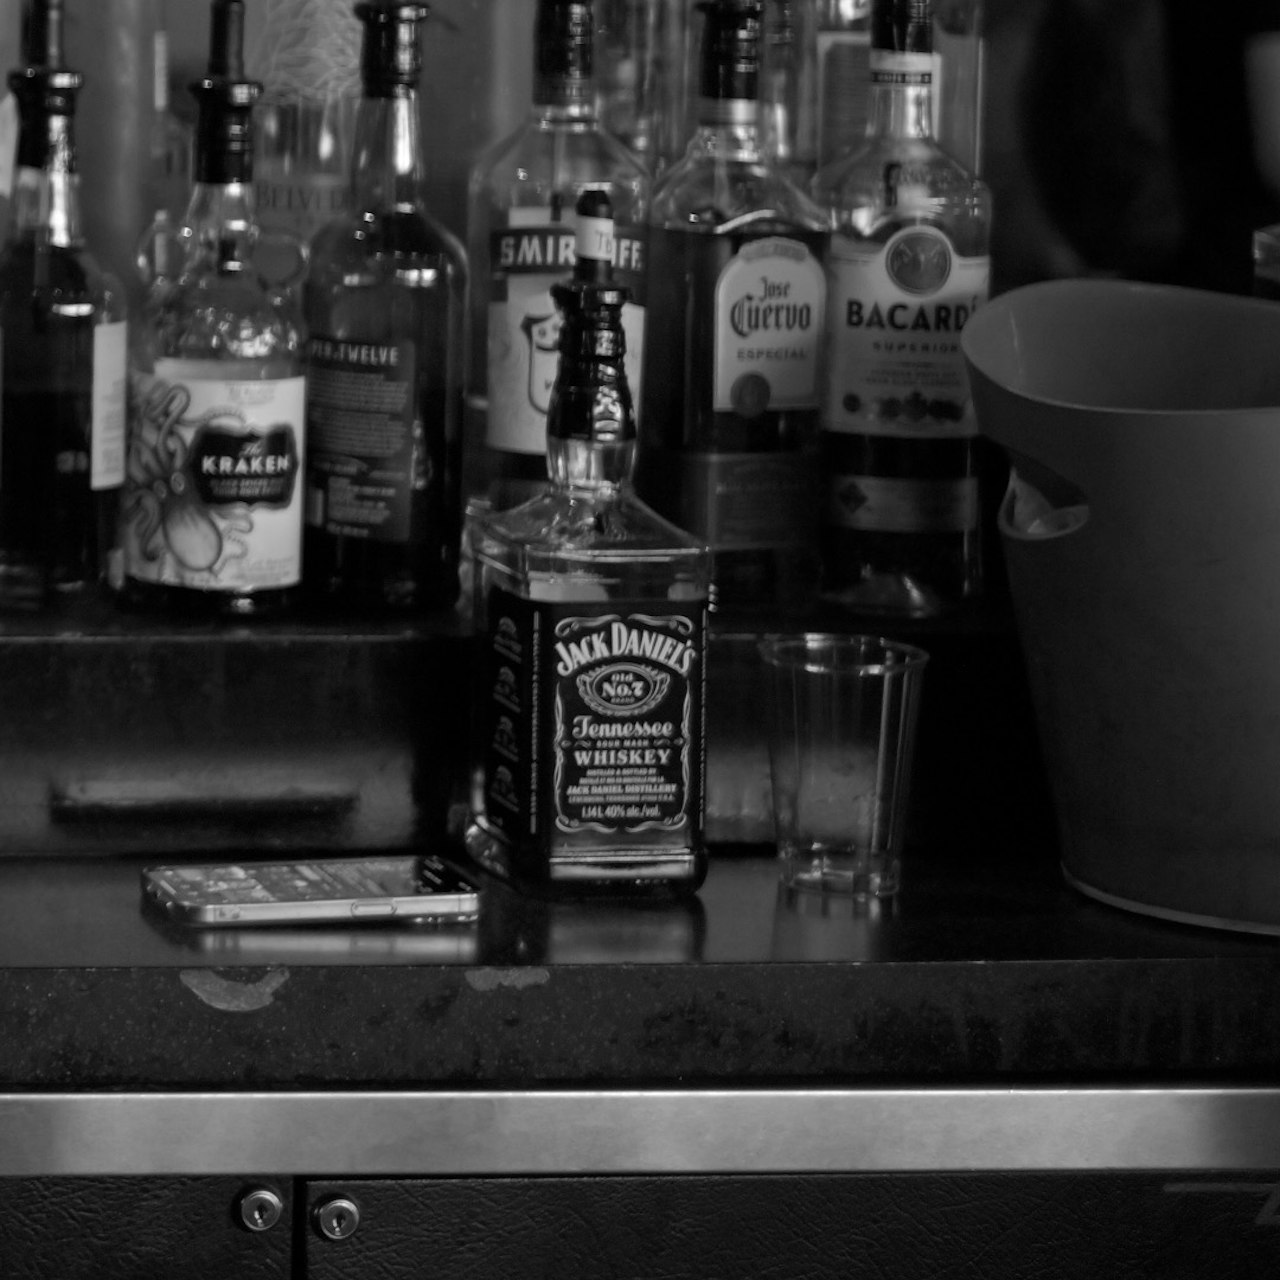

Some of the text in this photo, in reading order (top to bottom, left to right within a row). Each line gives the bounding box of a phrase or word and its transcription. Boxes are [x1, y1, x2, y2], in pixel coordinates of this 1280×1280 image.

[758, 276, 791, 302] Jose
[730, 293, 811, 338] Cuervo
[338, 342, 400, 367] TWELVE
[736, 348, 808, 362] ESPECIAL
[202, 455, 289, 475] KRAKEN
[554, 622, 696, 678] JACK DANIEL'S
[572, 715, 674, 739] Tennessee
[574, 748, 672, 767] WHISKEY
